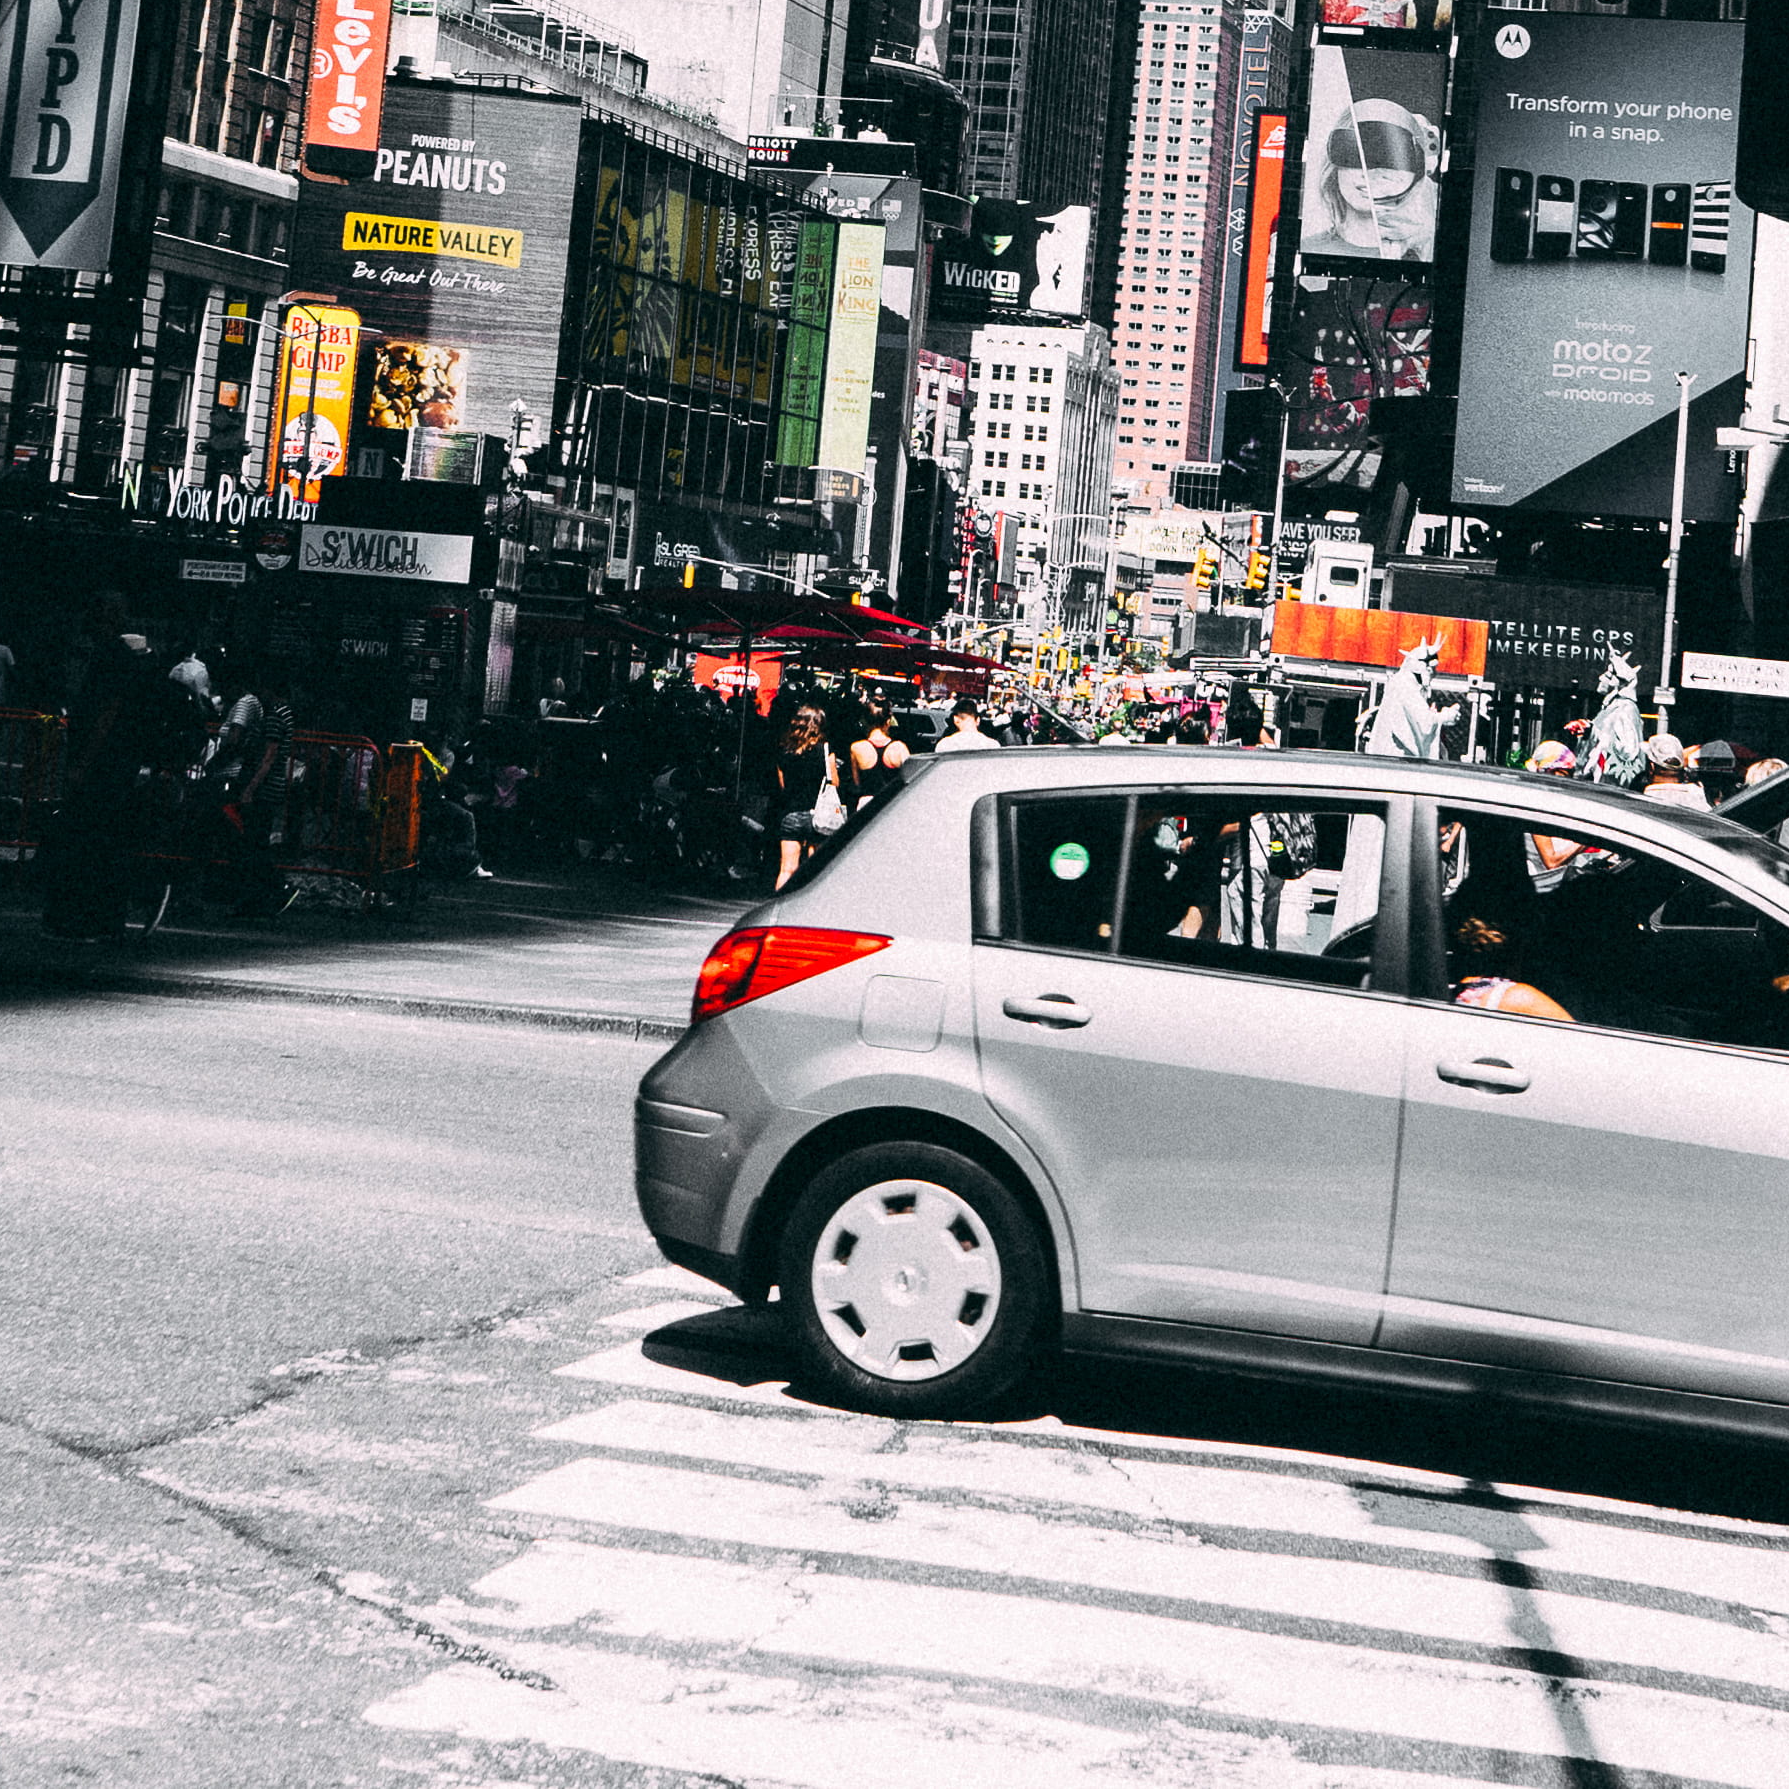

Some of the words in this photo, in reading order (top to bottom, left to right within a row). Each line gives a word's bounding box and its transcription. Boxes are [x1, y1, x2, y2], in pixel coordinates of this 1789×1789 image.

[1506, 93, 1609, 116] Transform
[1614, 99, 1661, 119] your
[1666, 101, 1733, 122] phone
[411, 134, 460, 152] POWERED
[461, 138, 476, 153] BY
[748, 137, 798, 150] RRIOTT
[1569, 121, 1587, 138] in
[1592, 126, 1604, 139] a
[1611, 126, 1665, 143] snap.
[748, 149, 789, 161] RQUIS
[373, 148, 507, 195] PEANUTS
[353, 220, 435, 248] NATURE
[439, 229, 515, 258] VALLEY
[848, 257, 870, 269] THE
[352, 261, 377, 280] Be
[380, 266, 426, 286] Great
[429, 268, 460, 289] Out
[459, 273, 507, 294] There
[842, 268, 874, 289] LION
[837, 290, 876, 313] KING
[292, 316, 352, 346] BUBBA
[1574, 317, 1637, 335] Introducing
[292, 346, 346, 372] GUMP
[1552, 363, 1652, 383] DROID
[1727, 448, 1737, 473] Leno
[167, 466, 213, 522] YORK
[1280, 521, 1306, 539] AVE
[1308, 524, 1331, 540] YOU
[322, 530, 418, 567] S'WICH
[1490, 620, 1581, 643] TELLITE
[1592, 627, 1634, 646] GPS
[1487, 640, 1623, 662] IMEKEEPIN
